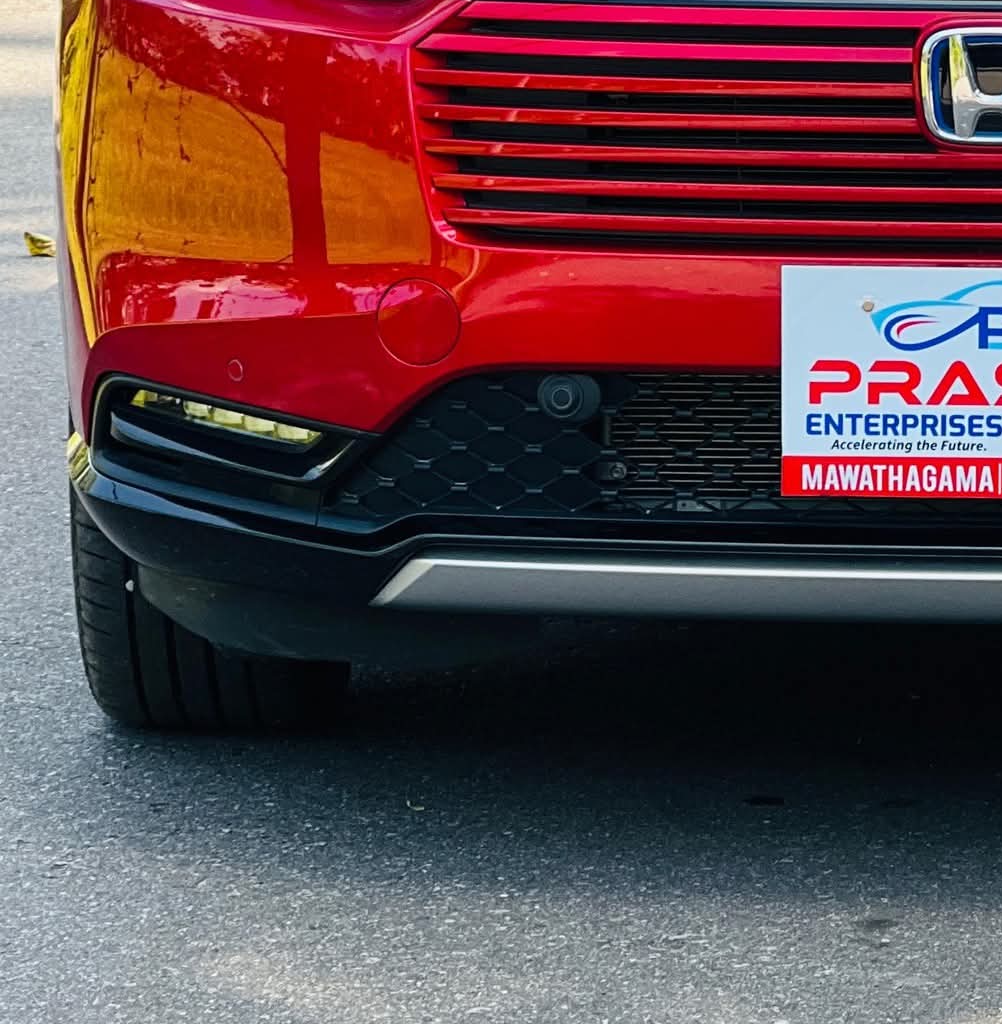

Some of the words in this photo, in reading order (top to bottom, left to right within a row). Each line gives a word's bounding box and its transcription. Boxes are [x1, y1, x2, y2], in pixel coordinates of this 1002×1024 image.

[806, 413, 1002, 438] ENTERPRISES
[831, 439, 912, 453] Accelerating
[916, 440, 937, 451] the
[940, 440, 988, 452] Future.
[801, 463, 995, 493] MAWATHAGAMA
